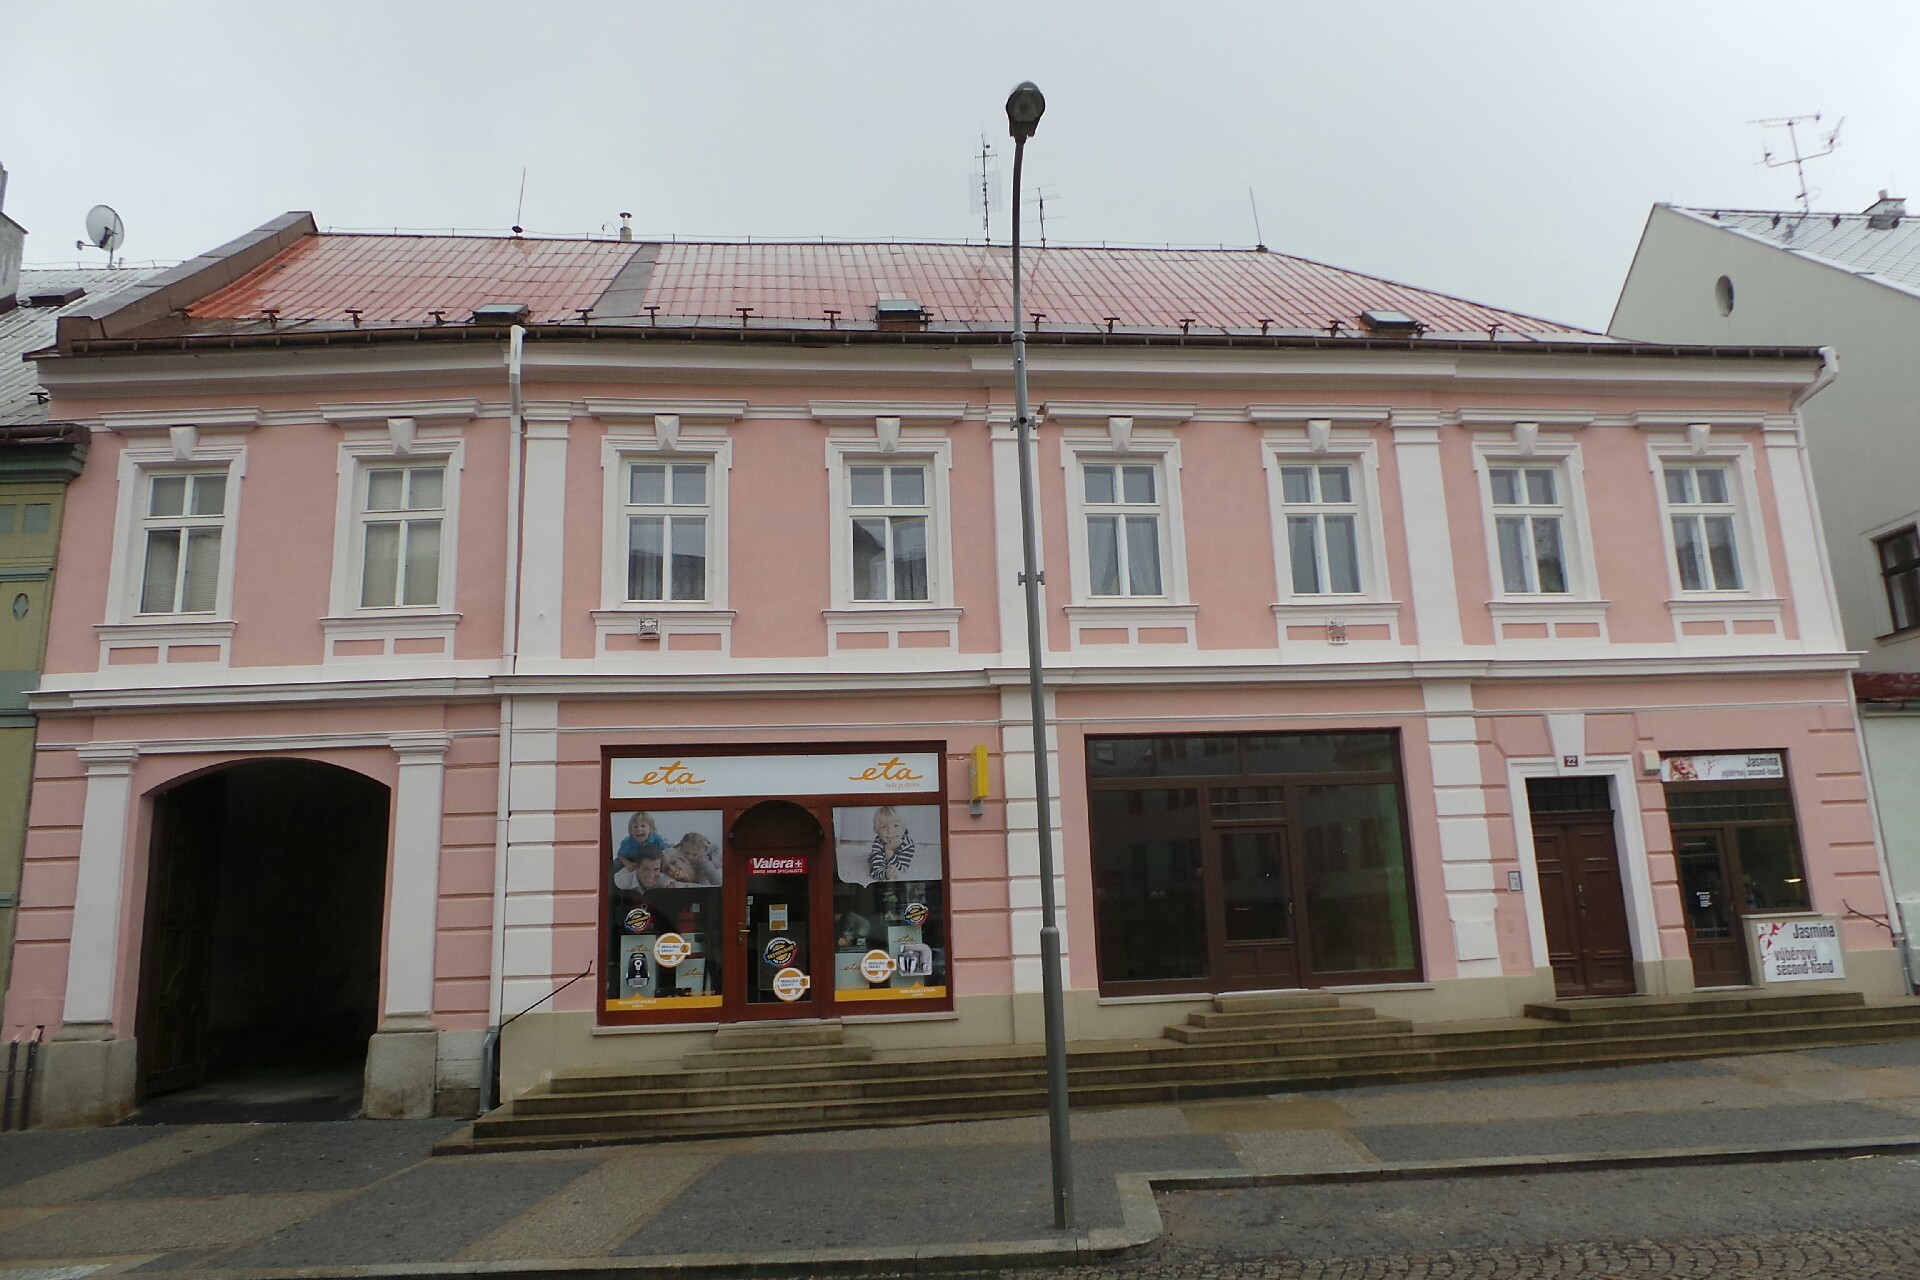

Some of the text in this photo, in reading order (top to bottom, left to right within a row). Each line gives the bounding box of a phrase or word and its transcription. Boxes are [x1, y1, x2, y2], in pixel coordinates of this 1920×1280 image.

[848, 757, 923, 780] eta
[1746, 756, 1779, 767] Jasmina
[628, 761, 705, 785] eta
[753, 858, 793, 869] Valera
[1793, 923, 1835, 938] Jasmina
[1774, 945, 1817, 963] výběrový
[1776, 959, 1834, 975] second-hand
